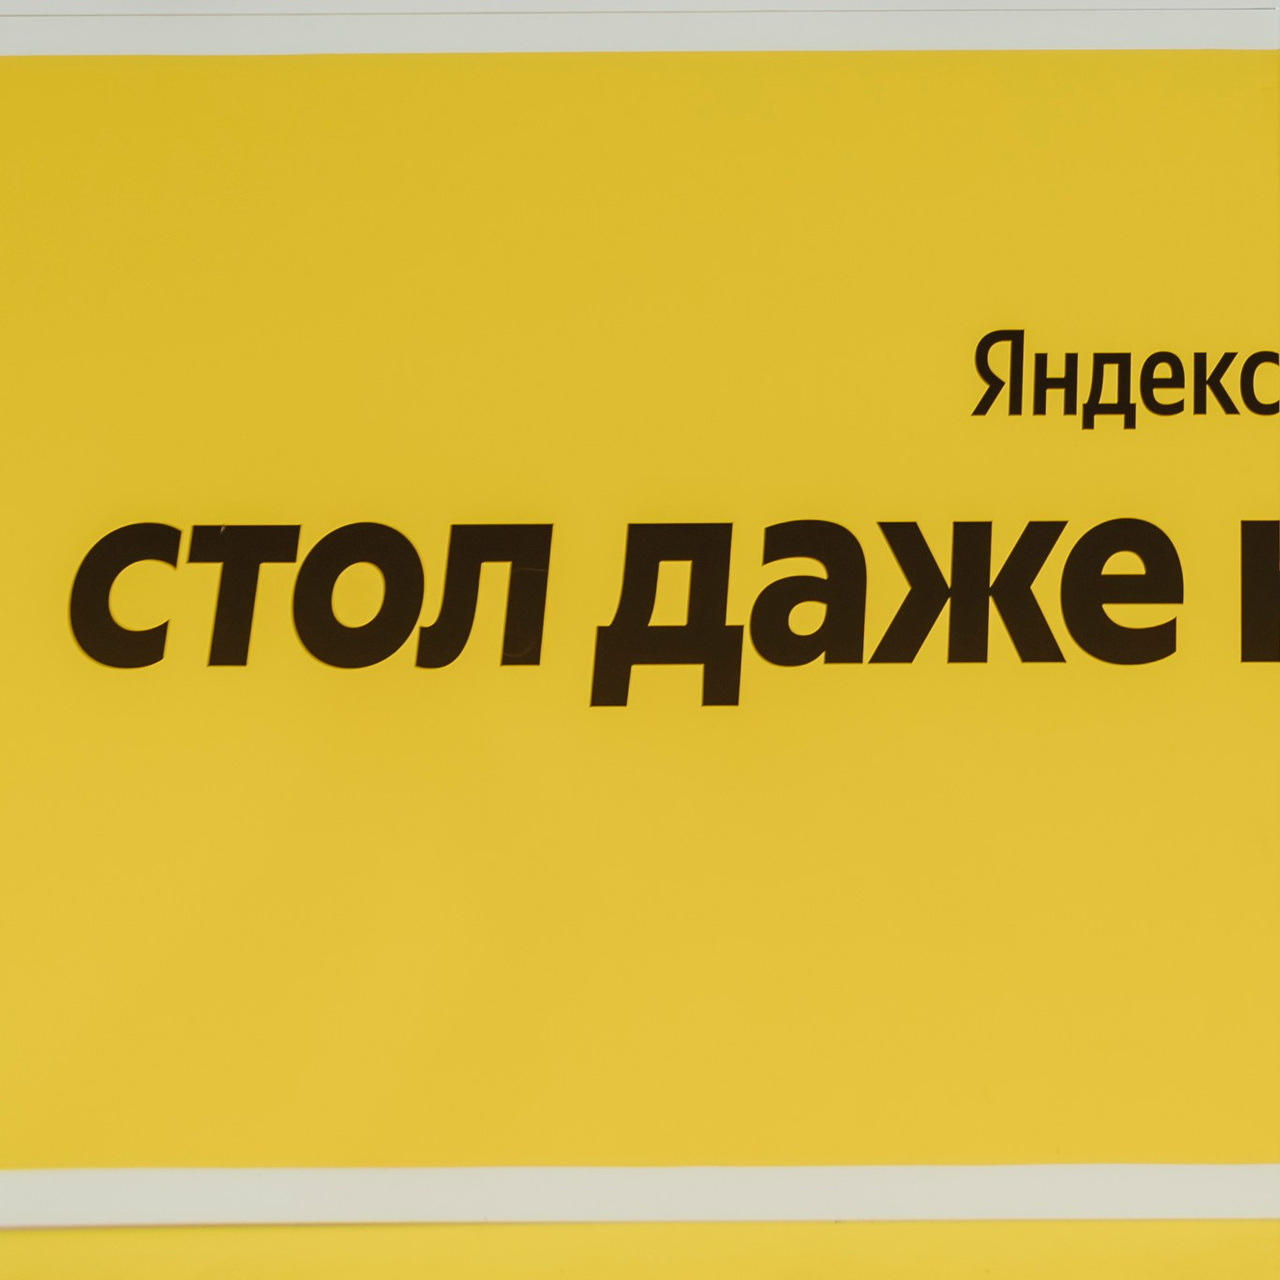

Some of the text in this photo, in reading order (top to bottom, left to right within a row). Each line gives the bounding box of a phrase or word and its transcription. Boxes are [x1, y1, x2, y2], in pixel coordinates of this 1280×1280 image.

[972, 329, 1280, 430] Яндекс
[69, 521, 554, 670] стол
[591, 517, 1184, 707] даже
